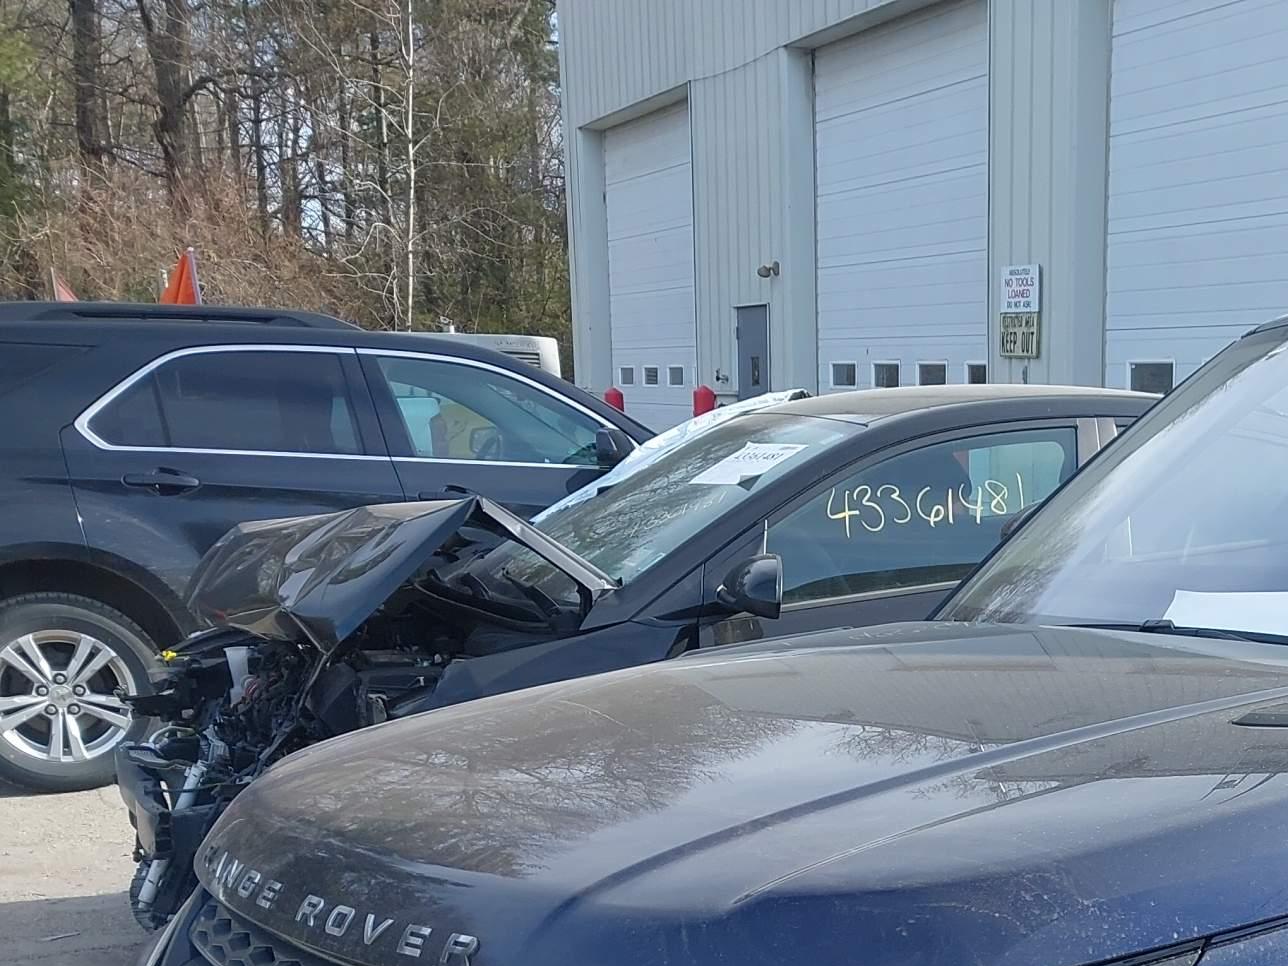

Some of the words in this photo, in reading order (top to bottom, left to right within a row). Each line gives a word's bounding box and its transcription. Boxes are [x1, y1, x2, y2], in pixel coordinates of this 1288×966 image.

[1005, 279, 1013, 288] NO
[1015, 277, 1034, 287] TOOLS
[1007, 289, 1030, 299] LOANED
[1002, 331, 1017, 353] KEEP
[1021, 332, 1034, 354] OUT
[826, 473, 1024, 538] 43361481
